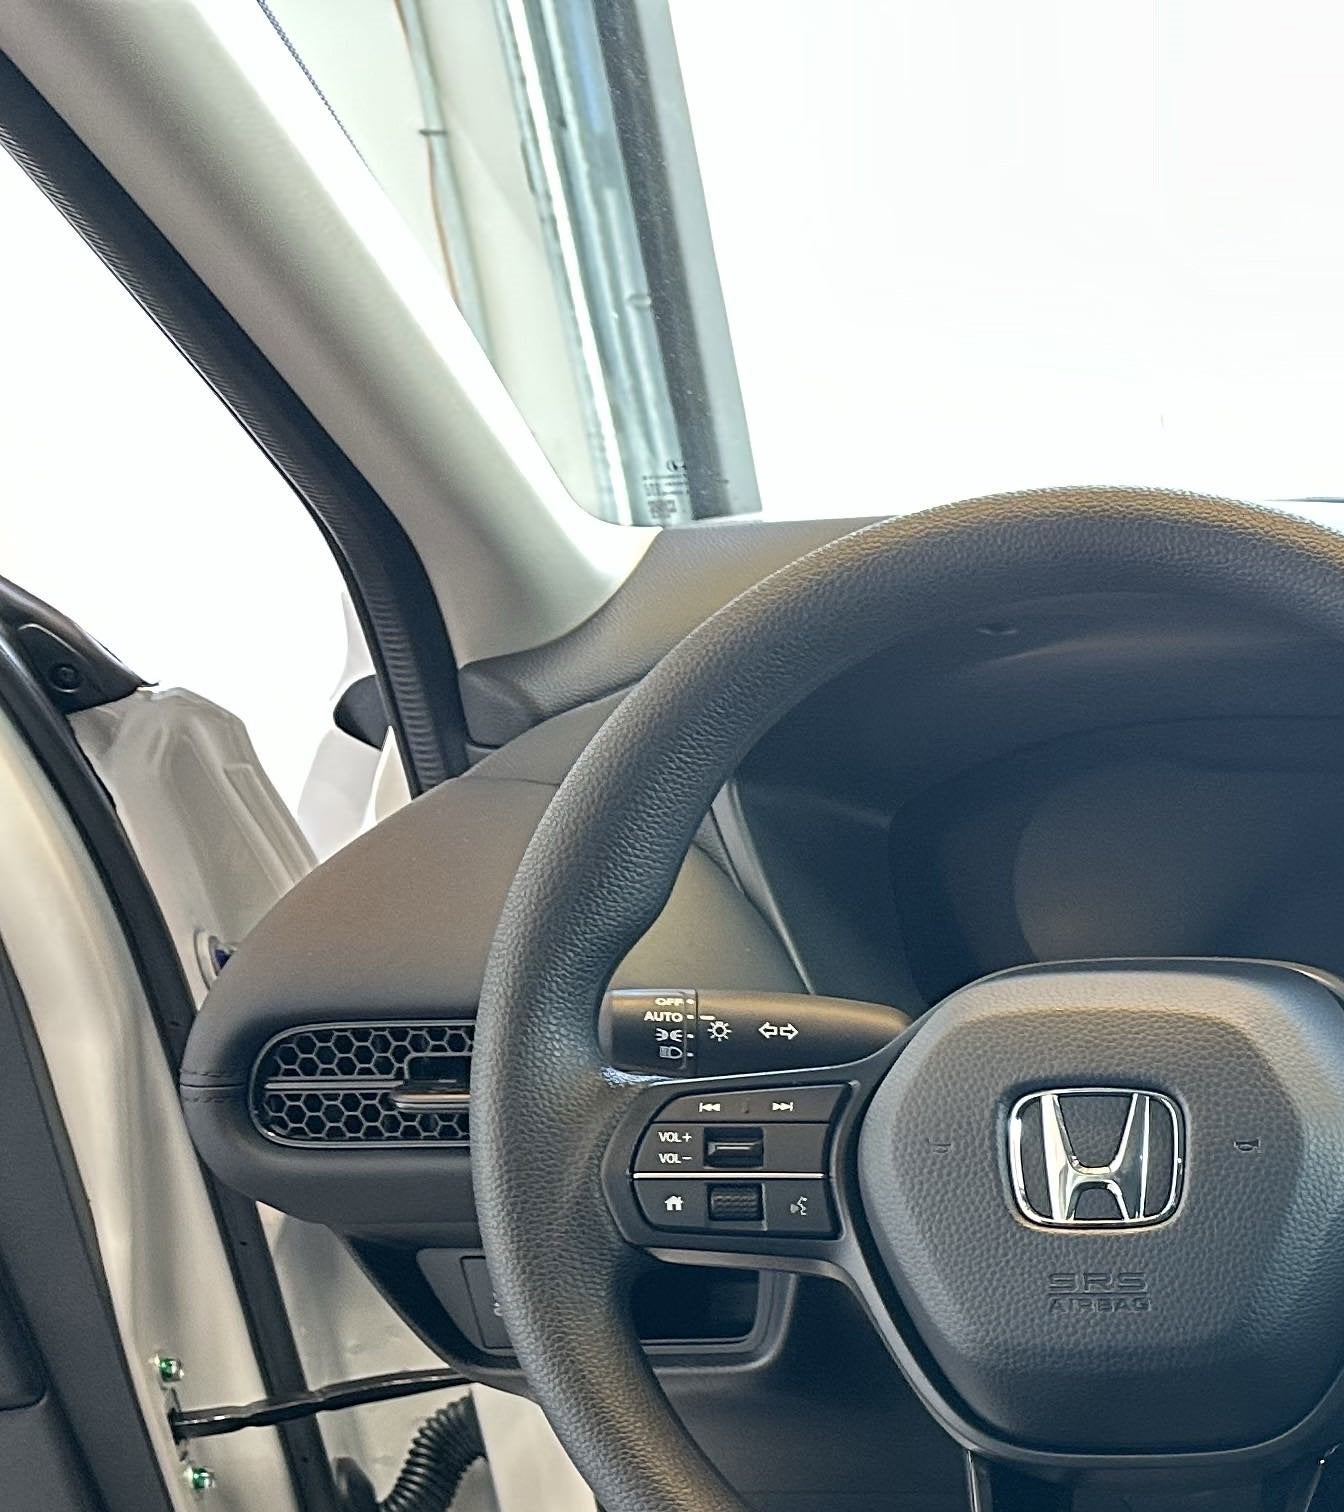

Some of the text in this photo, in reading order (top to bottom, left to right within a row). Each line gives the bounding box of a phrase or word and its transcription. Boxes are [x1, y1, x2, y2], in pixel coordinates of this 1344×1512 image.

[655, 997, 684, 1006] OFF
[643, 1010, 683, 1022] AUTO
[1048, 1272, 1148, 1293] SRS
